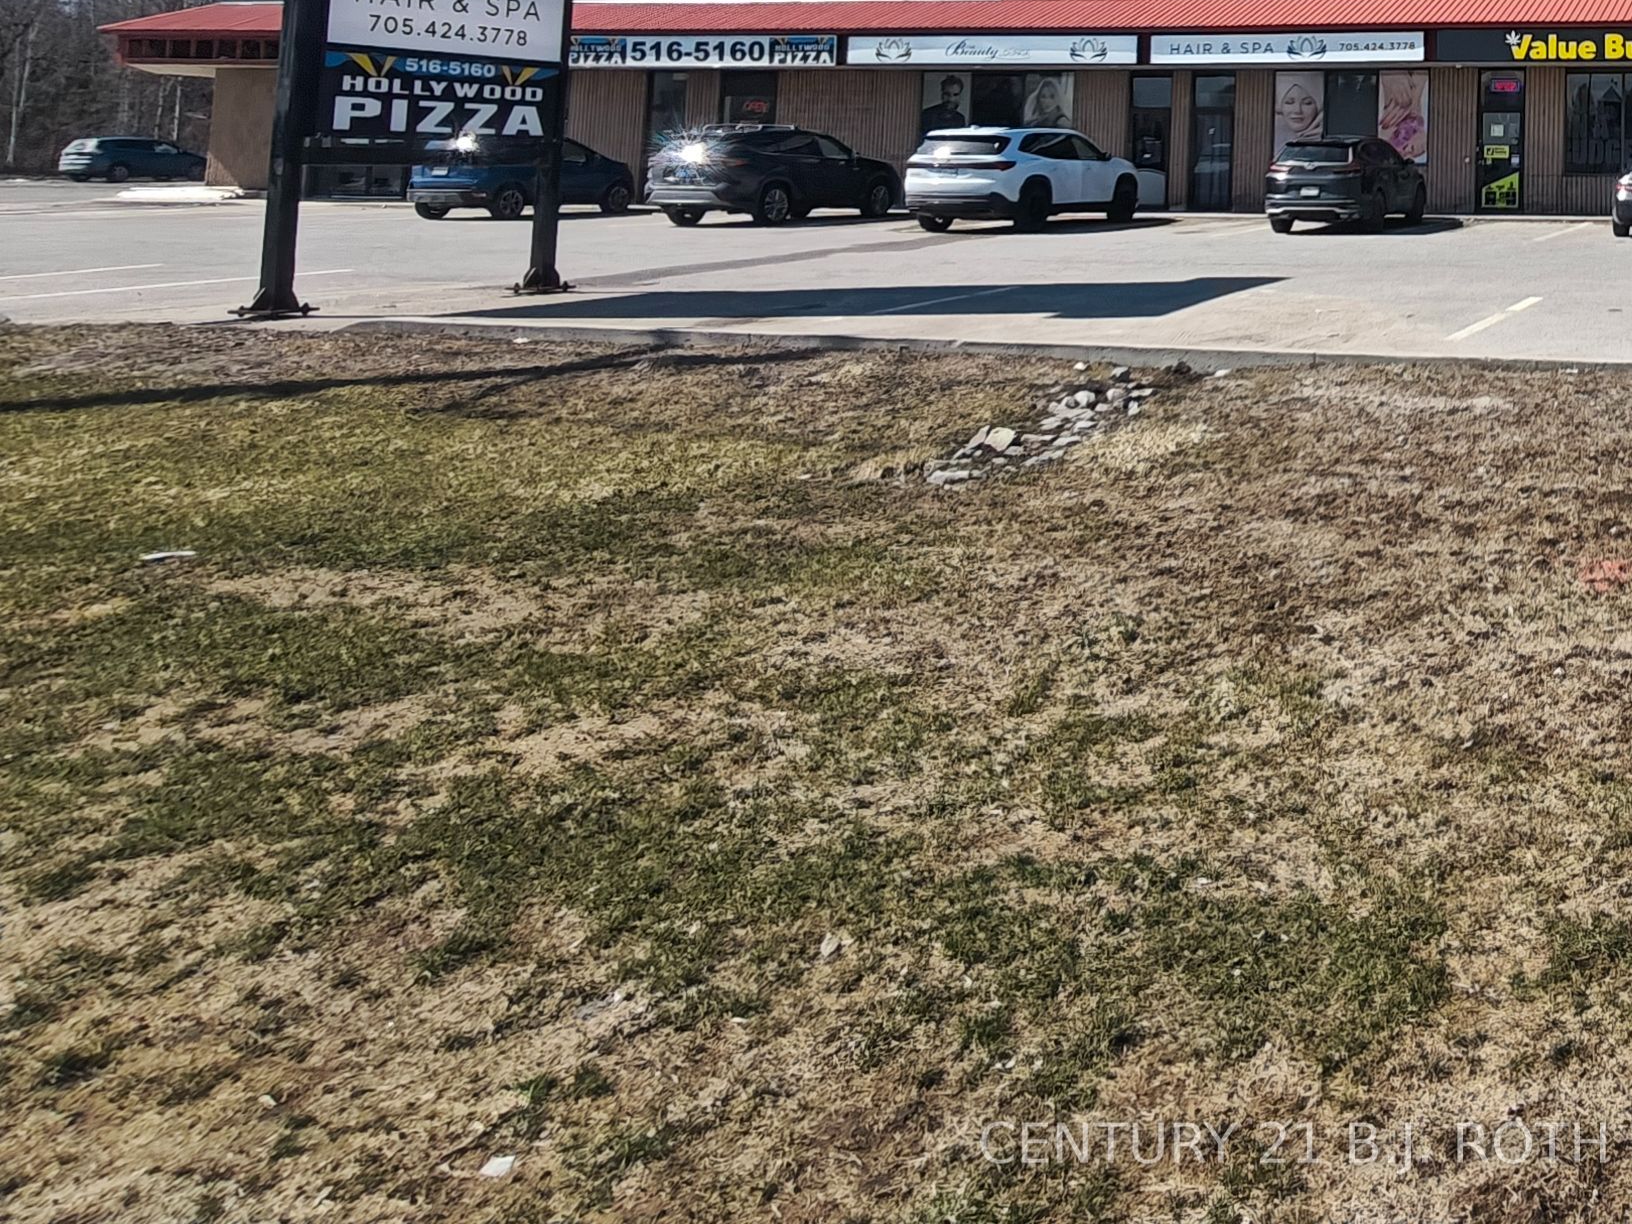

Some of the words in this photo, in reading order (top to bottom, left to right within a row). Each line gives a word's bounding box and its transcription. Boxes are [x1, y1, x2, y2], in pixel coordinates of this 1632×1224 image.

[368, 14, 528, 47] 705.424.3778
[630, 41, 765, 63] 516-5160
[1170, 42, 1213, 55] HAIR
[1220, 42, 1231, 55] &
[1240, 41, 1275, 54] SPA
[1339, 41, 1416, 52] 705.424.3778
[1510, 33, 1597, 60] Value
[404, 58, 496, 78] 516-5160
[569, 52, 622, 65] PIZZA
[773, 51, 832, 65] PIZZA
[342, 75, 544, 102] HOLLYWOOD
[332, 95, 545, 137] PIZZA
